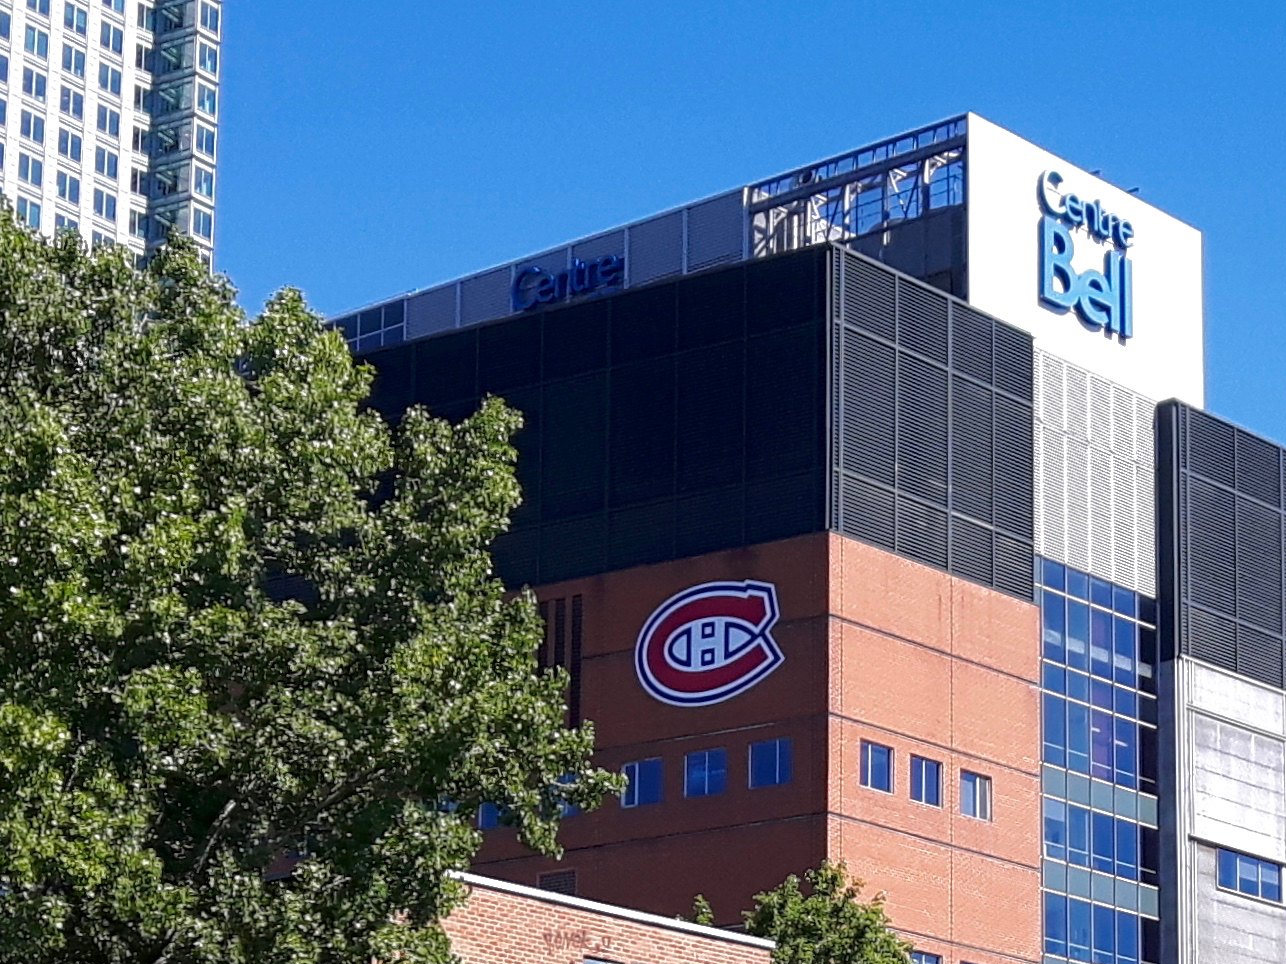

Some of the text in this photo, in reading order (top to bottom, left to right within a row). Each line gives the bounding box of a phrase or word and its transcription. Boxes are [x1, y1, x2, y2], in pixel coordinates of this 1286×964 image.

[1036, 169, 1135, 248] Centre
[512, 254, 624, 311] Centre
[1038, 214, 1134, 345] Bell
